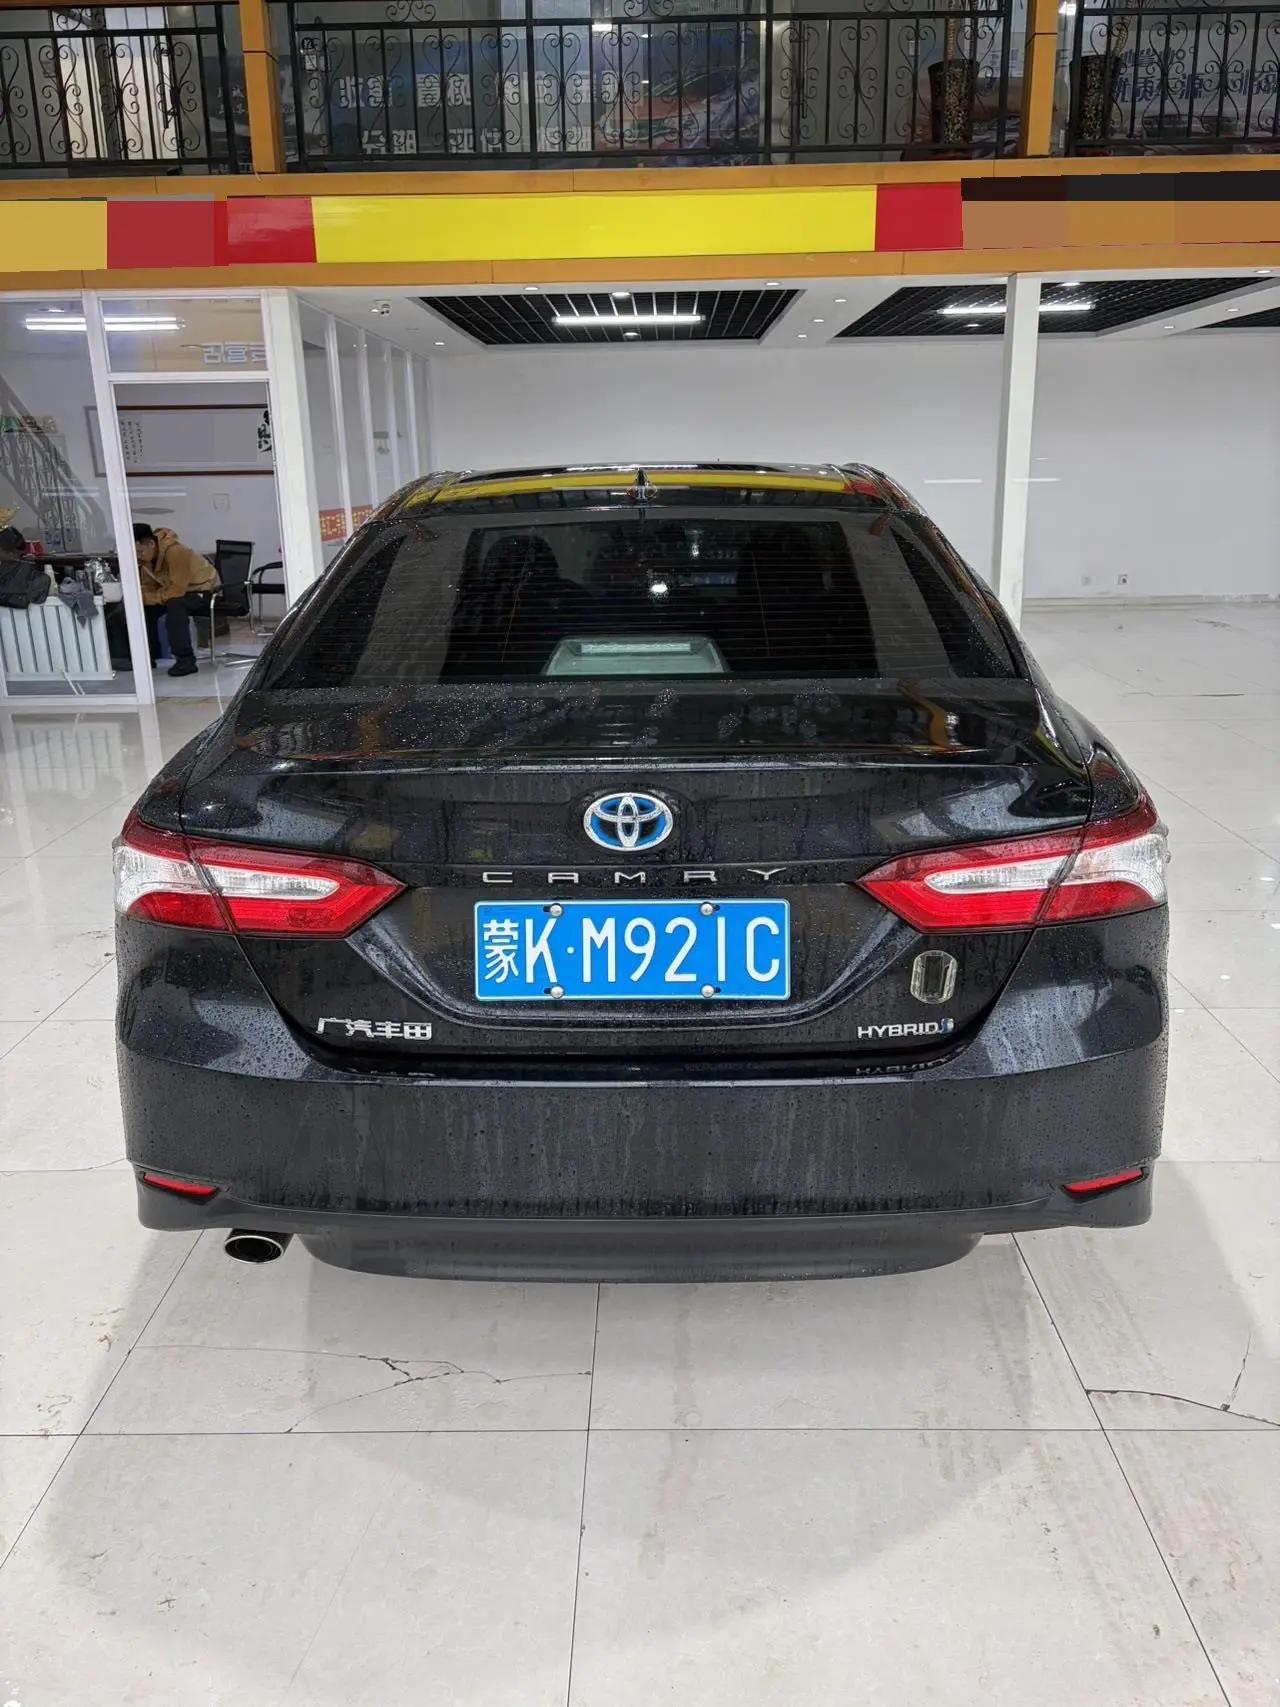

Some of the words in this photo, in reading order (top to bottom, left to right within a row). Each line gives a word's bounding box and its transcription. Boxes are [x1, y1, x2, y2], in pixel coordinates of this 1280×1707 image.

[482, 867, 787, 884] CAMRY
[316, 1017, 432, 1041] 广汽丰田
